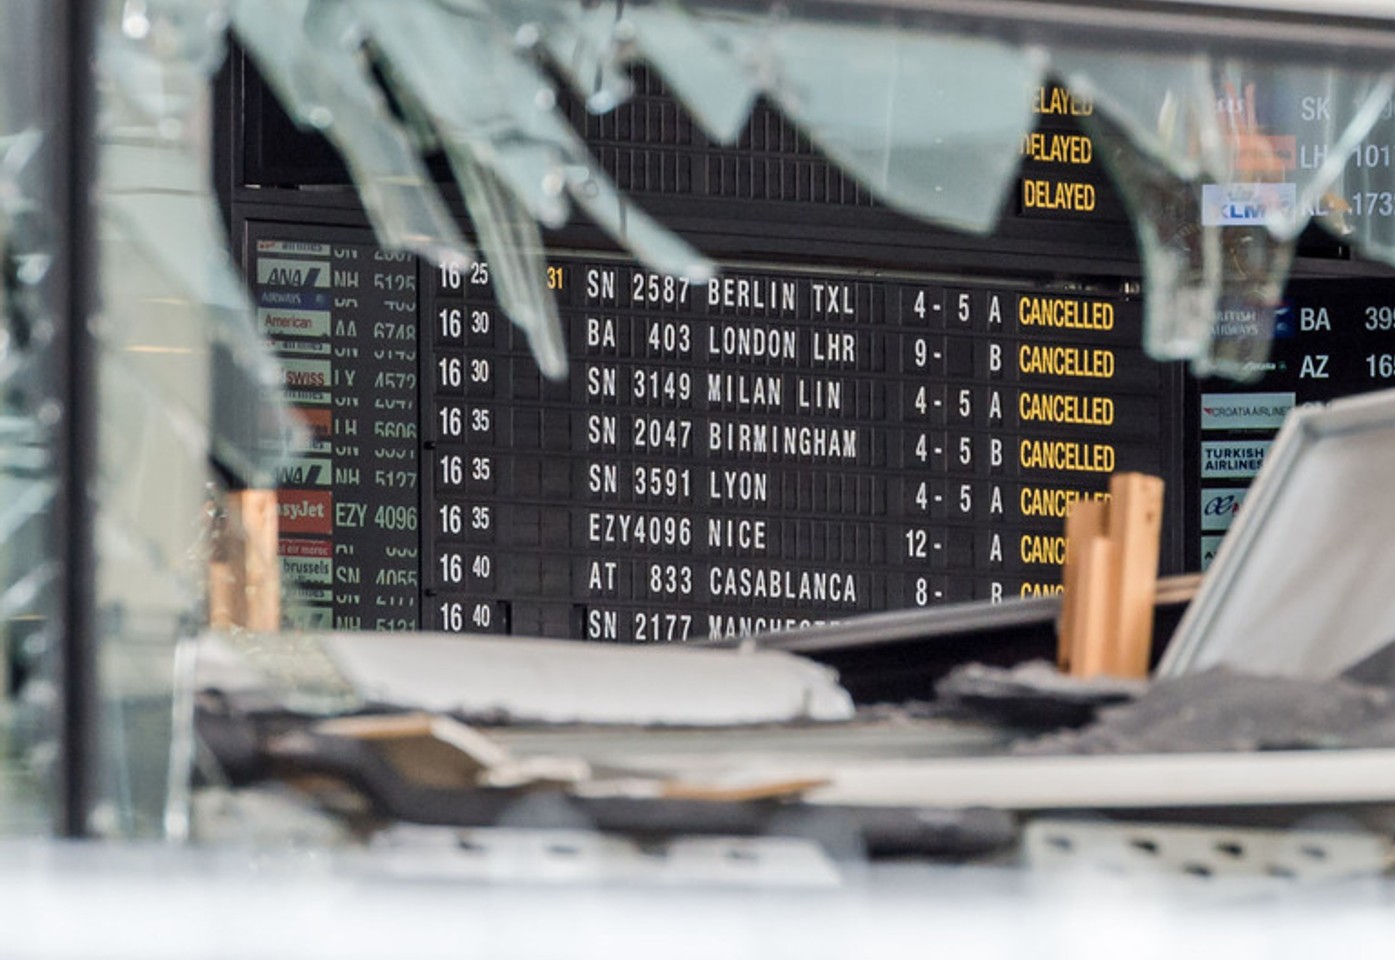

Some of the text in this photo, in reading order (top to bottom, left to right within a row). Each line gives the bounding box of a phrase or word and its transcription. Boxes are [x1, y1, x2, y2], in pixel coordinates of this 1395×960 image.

[1025, 180, 1094, 210] DELAYED
[587, 270, 1113, 330] SN 2587 BERLIN TXL CANCELLED
[1301, 308, 1330, 330] BA
[588, 319, 1114, 377] BA 403 LONDON LHR CANCELLED
[1300, 355, 1329, 378] AZ
[588, 367, 1113, 425] SN 3149 MILAN LIN CANCELLED
[589, 415, 1114, 472] SN 2047 BIRMINGHAM CANCELLED
[336, 503, 417, 530] EZY 4096
[589, 562, 855, 601] AT 833 CASABLANCA
